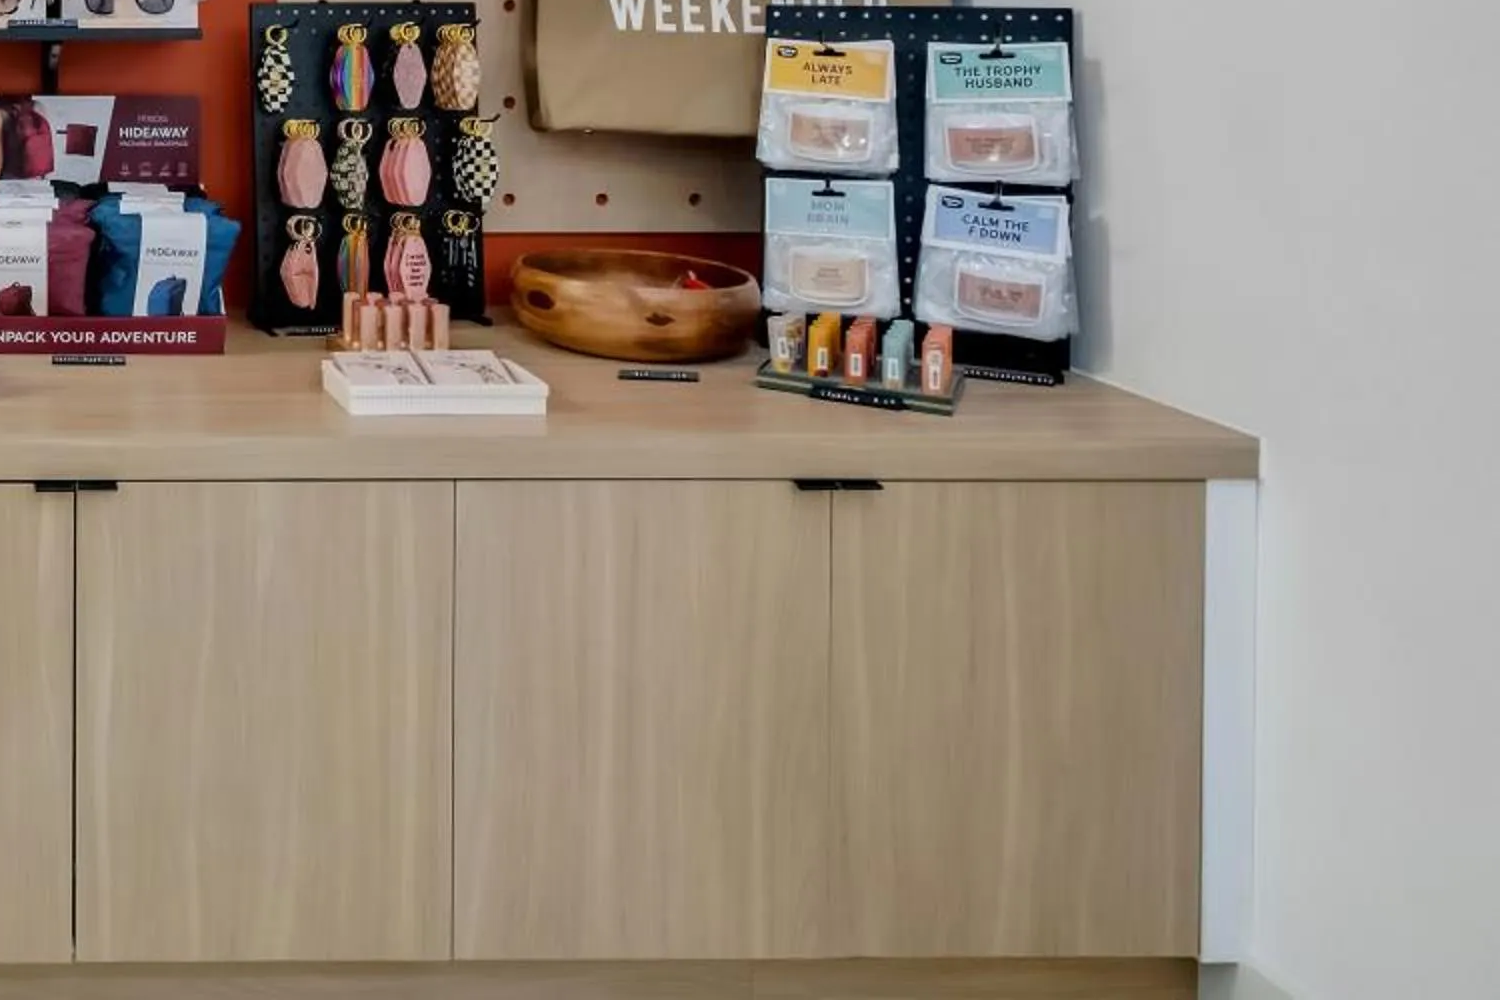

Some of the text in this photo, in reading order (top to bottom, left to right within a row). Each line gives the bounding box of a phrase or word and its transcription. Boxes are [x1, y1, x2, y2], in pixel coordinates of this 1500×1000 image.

[803, 62, 853, 75] ALWAYS
[954, 65, 1041, 77] THE TROPHY
[811, 75, 842, 86] LATE
[965, 77, 1033, 89] HUSBAND
[119, 127, 189, 139] HIDEAWAY
[811, 200, 845, 212] MOM
[962, 213, 1029, 233] CALM THE
[968, 225, 1021, 243] F DOWN
[145, 248, 199, 258] HIDEAWAY
[50, 331, 96, 344] YOUR
[99, 331, 197, 344] ADVENTURE
